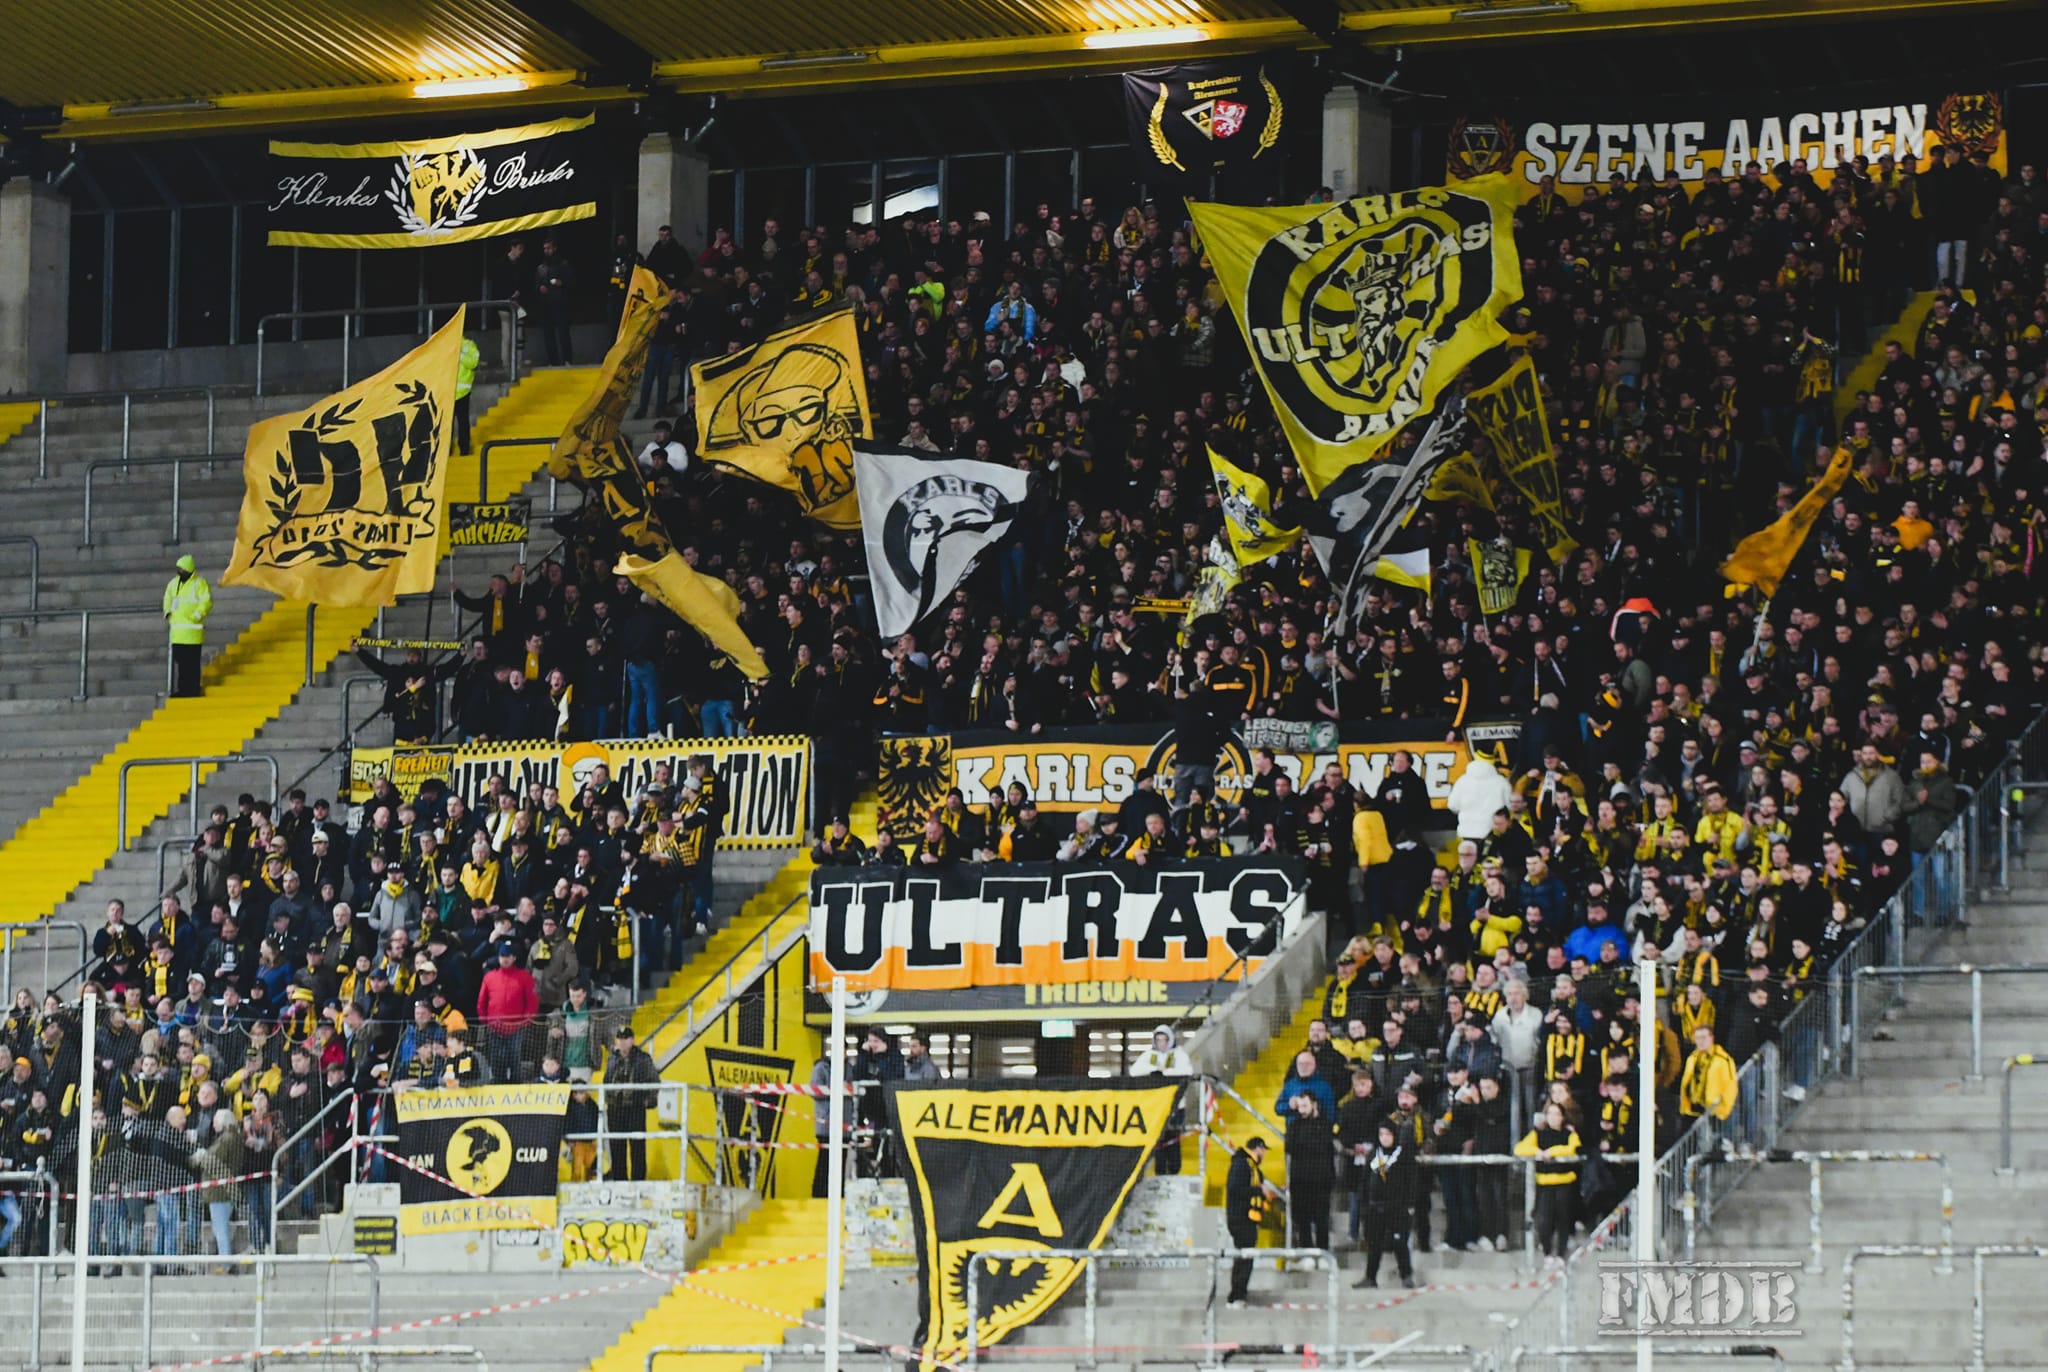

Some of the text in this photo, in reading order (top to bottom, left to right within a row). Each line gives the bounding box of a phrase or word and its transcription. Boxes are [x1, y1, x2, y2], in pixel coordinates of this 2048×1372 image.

[1525, 104, 1927, 184] SZENE AACHEN
[268, 152, 574, 211] Klenkes Brüder
[900, 474, 998, 512] KARLS
[956, 754, 1136, 804] KARLS
[822, 869, 1293, 973] ULTRAS
[1024, 980, 1168, 1005] TRIBUNE
[718, 1066, 781, 1084] ALEMANNIA
[399, 1089, 567, 1113] ALEMANNIA AACHEN
[916, 1102, 1147, 1135] ALEMANNIA
[516, 1147, 548, 1163] CLUB
[421, 1205, 471, 1226] BLACK
[977, 1162, 1064, 1238] A
